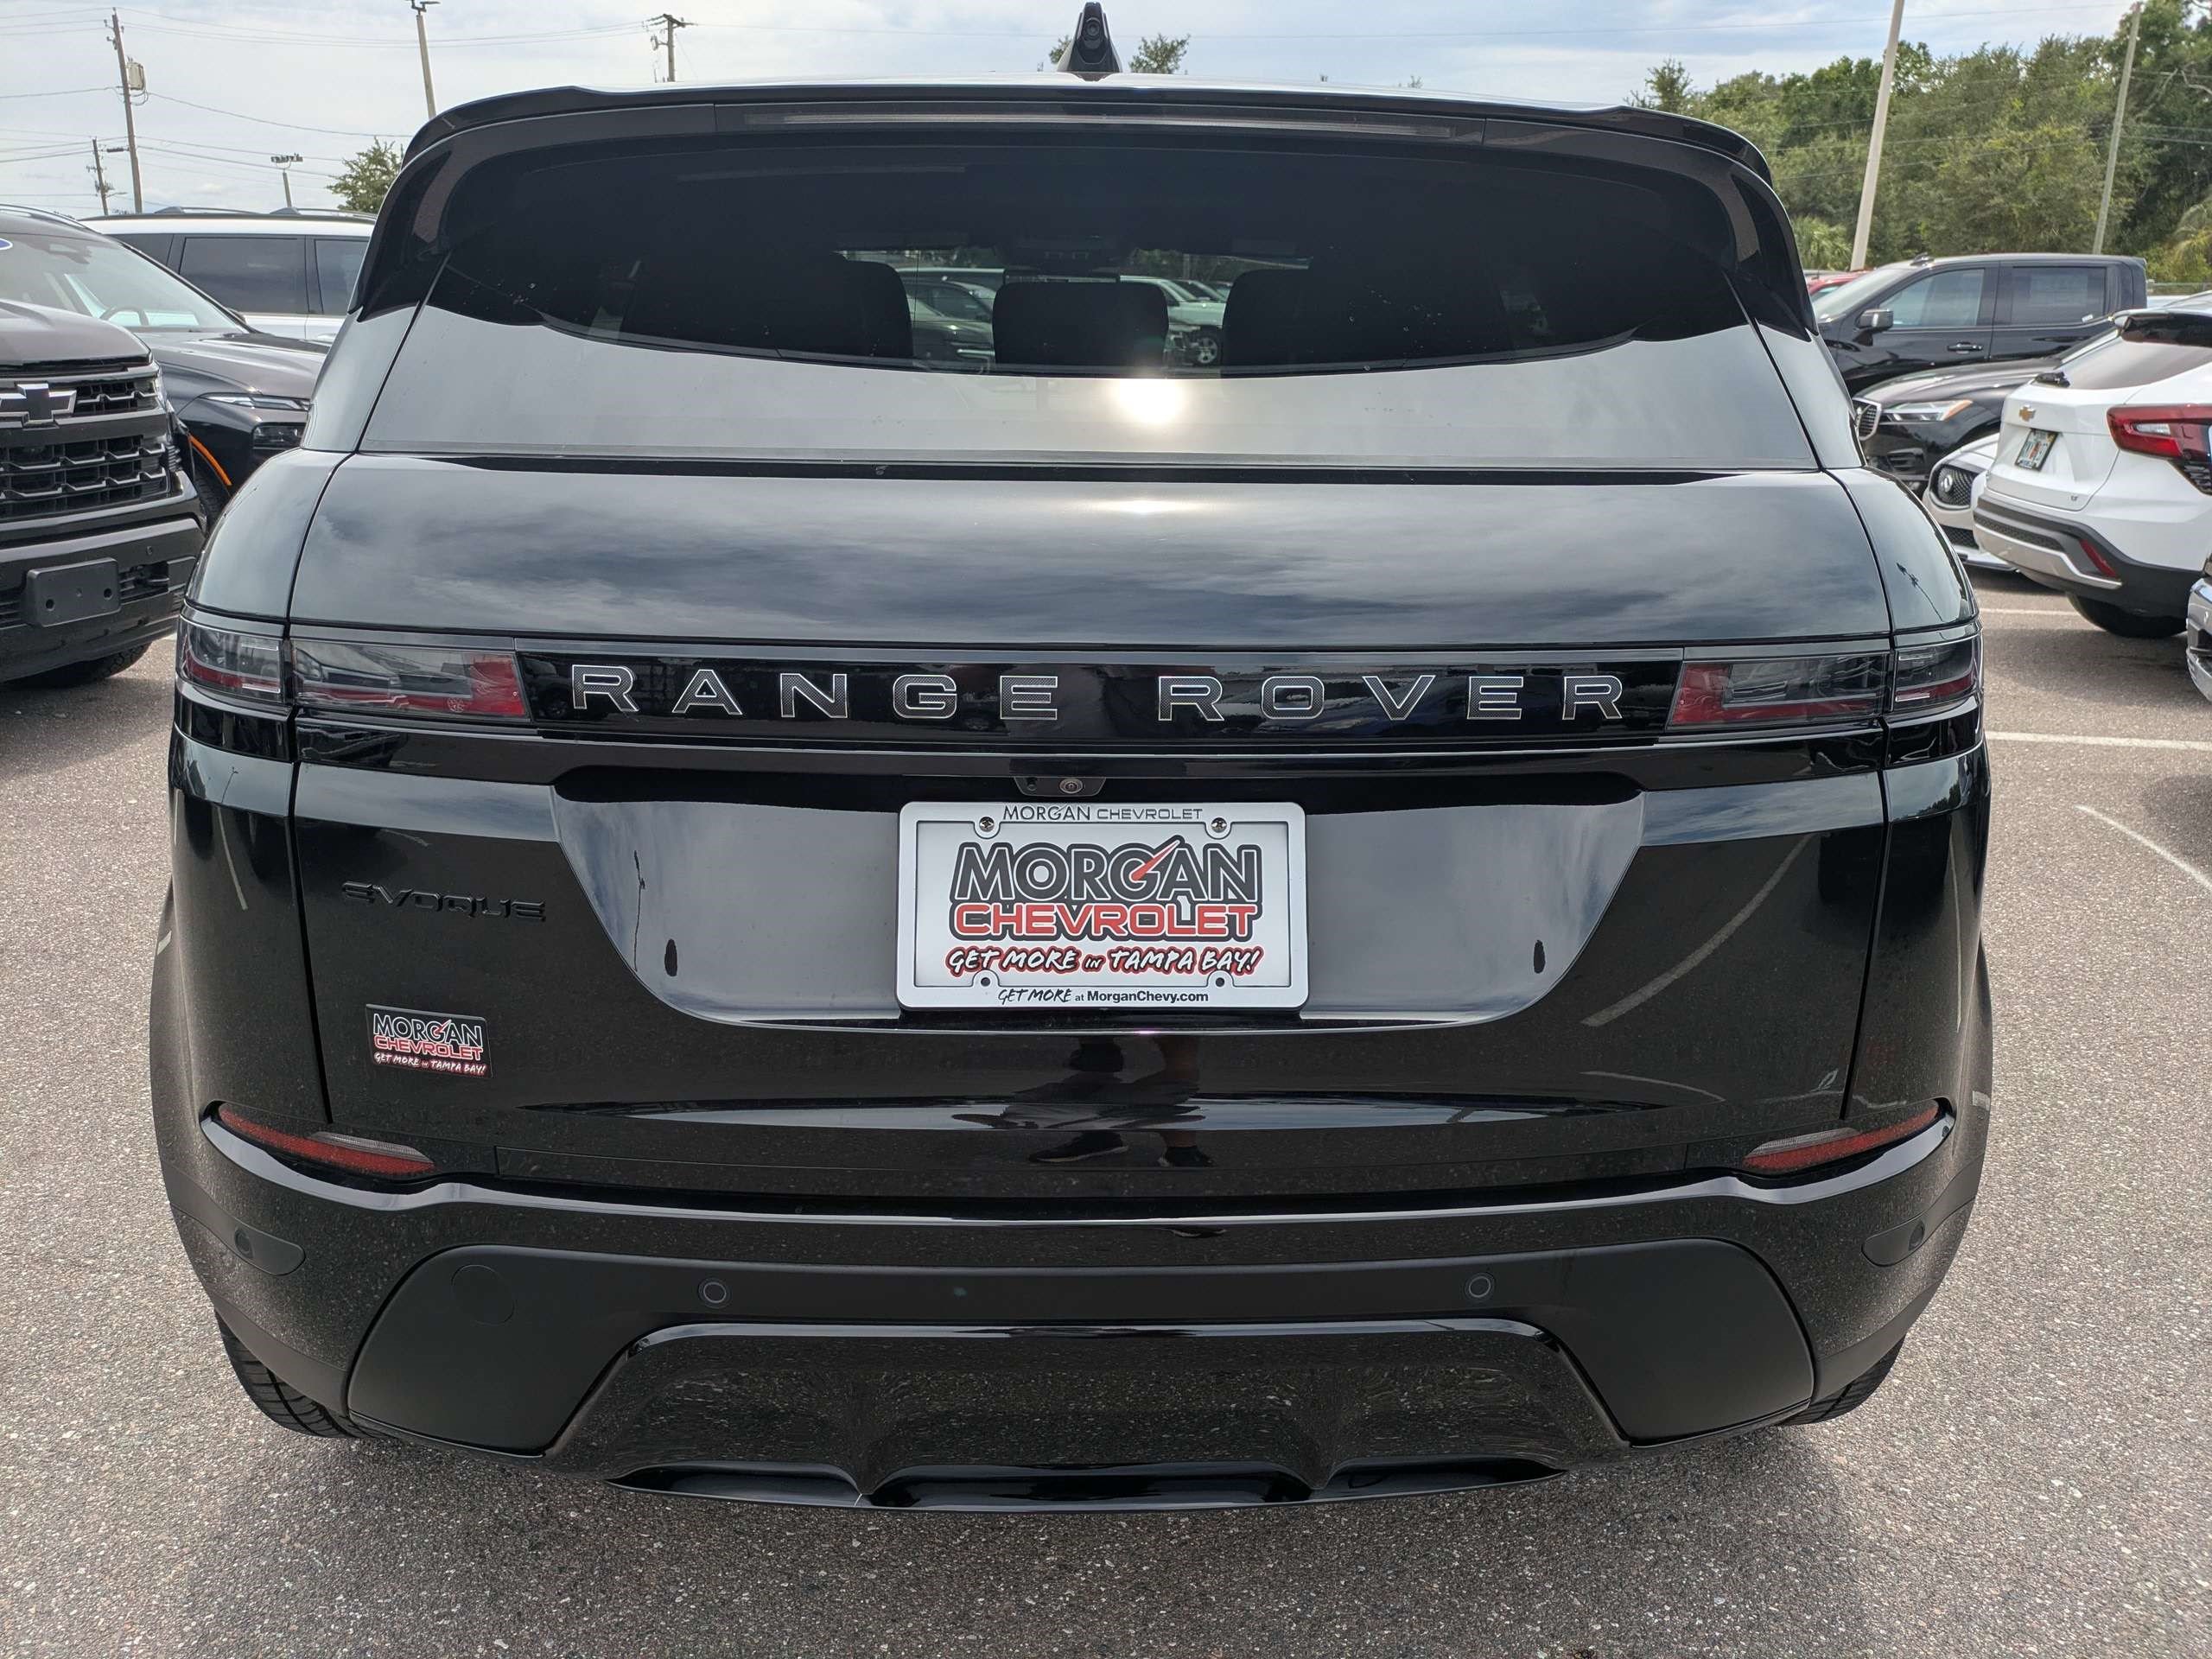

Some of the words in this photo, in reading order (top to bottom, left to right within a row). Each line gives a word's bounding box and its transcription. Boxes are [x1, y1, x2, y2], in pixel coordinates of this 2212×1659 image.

[571, 664, 1058, 721] RANGE
[1157, 675, 1624, 721] ROVER
[1002, 805, 1091, 821] MORGAN
[1096, 808, 1204, 820] CHEVROLET
[953, 836, 1260, 903] MORGAN
[342, 880, 546, 922] EVOQUE
[954, 903, 1258, 937] CHEVROLET
[949, 950, 1000, 972] GET
[1001, 950, 1078, 971] MORE
[1110, 950, 1195, 971] TAMPA
[1200, 950, 1259, 974] BAY!
[997, 988, 1029, 1005] GET
[1027, 988, 1072, 1003] MORE
[1086, 990, 1209, 1003] MorganChevy.com
[373, 1013, 484, 1048] MORGAN
[373, 1034, 484, 1062] CHEVROLET
[374, 1052, 392, 1065] GET
[392, 1055, 421, 1066] MORE
[430, 1059, 462, 1072] TAMPA
[464, 1064, 486, 1075] BAY!
